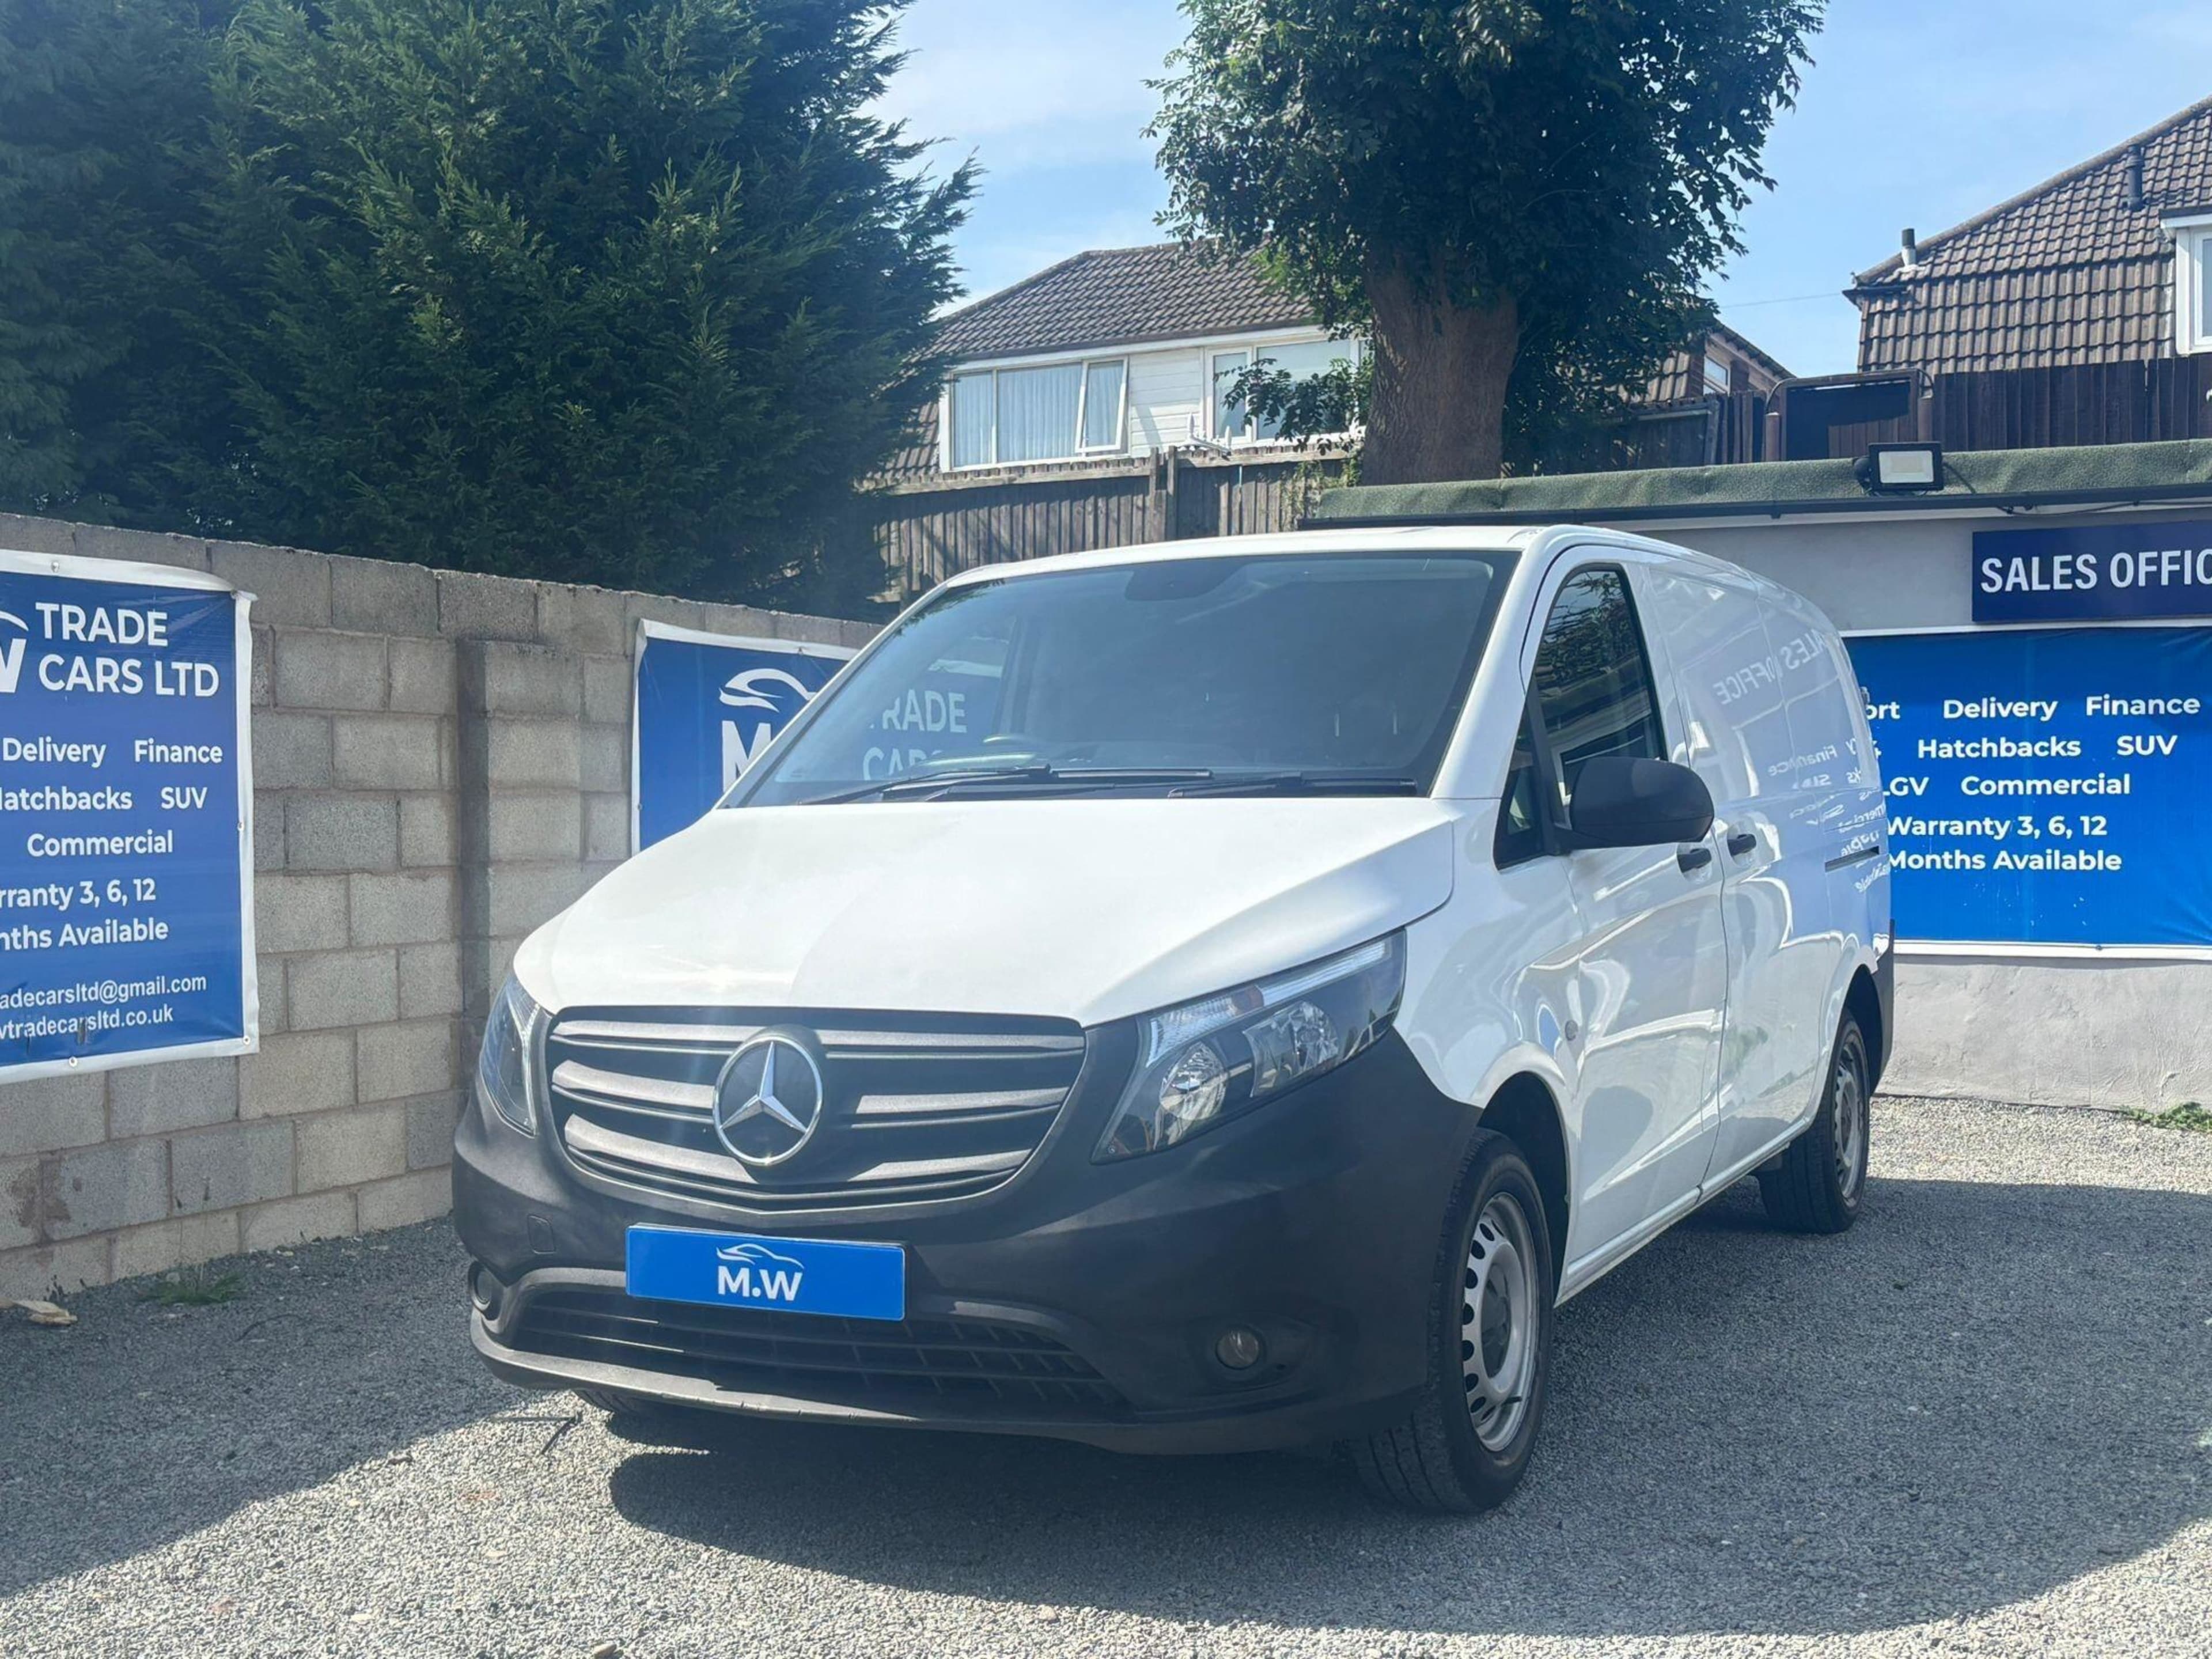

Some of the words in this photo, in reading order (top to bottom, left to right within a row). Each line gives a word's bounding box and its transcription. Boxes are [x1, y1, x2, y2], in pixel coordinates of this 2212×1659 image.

[1981, 554, 2097, 593] SALES
[2109, 548, 2212, 588] OFFIC
[35, 602, 168, 646] TRADE
[39, 654, 143, 694] CARS
[155, 661, 219, 697] LTD
[1944, 696, 2058, 721] Delivery
[2086, 694, 2200, 716] Finance
[3, 736, 107, 768] Delivery
[135, 738, 223, 763] Finance
[1918, 736, 2081, 759] Hatchbacks
[2117, 735, 2177, 756] SUV
[0, 786, 132, 810] atchbacks
[161, 787, 208, 809] SUV
[1961, 772, 2130, 796] Commercial
[1887, 816, 2011, 840] Warranty
[2017, 816, 2042, 839] 3,
[2048, 816, 2073, 839] 6,
[2080, 816, 2107, 835] 12
[27, 829, 173, 857] Commercial
[1889, 850, 1986, 870] Months
[1993, 849, 2122, 871] Available
[79, 881, 100, 908] 3,
[107, 879, 128, 906] 6,
[133, 878, 156, 901] 12
[58, 917, 169, 947] Available
[718, 1265, 803, 1301] M.W
